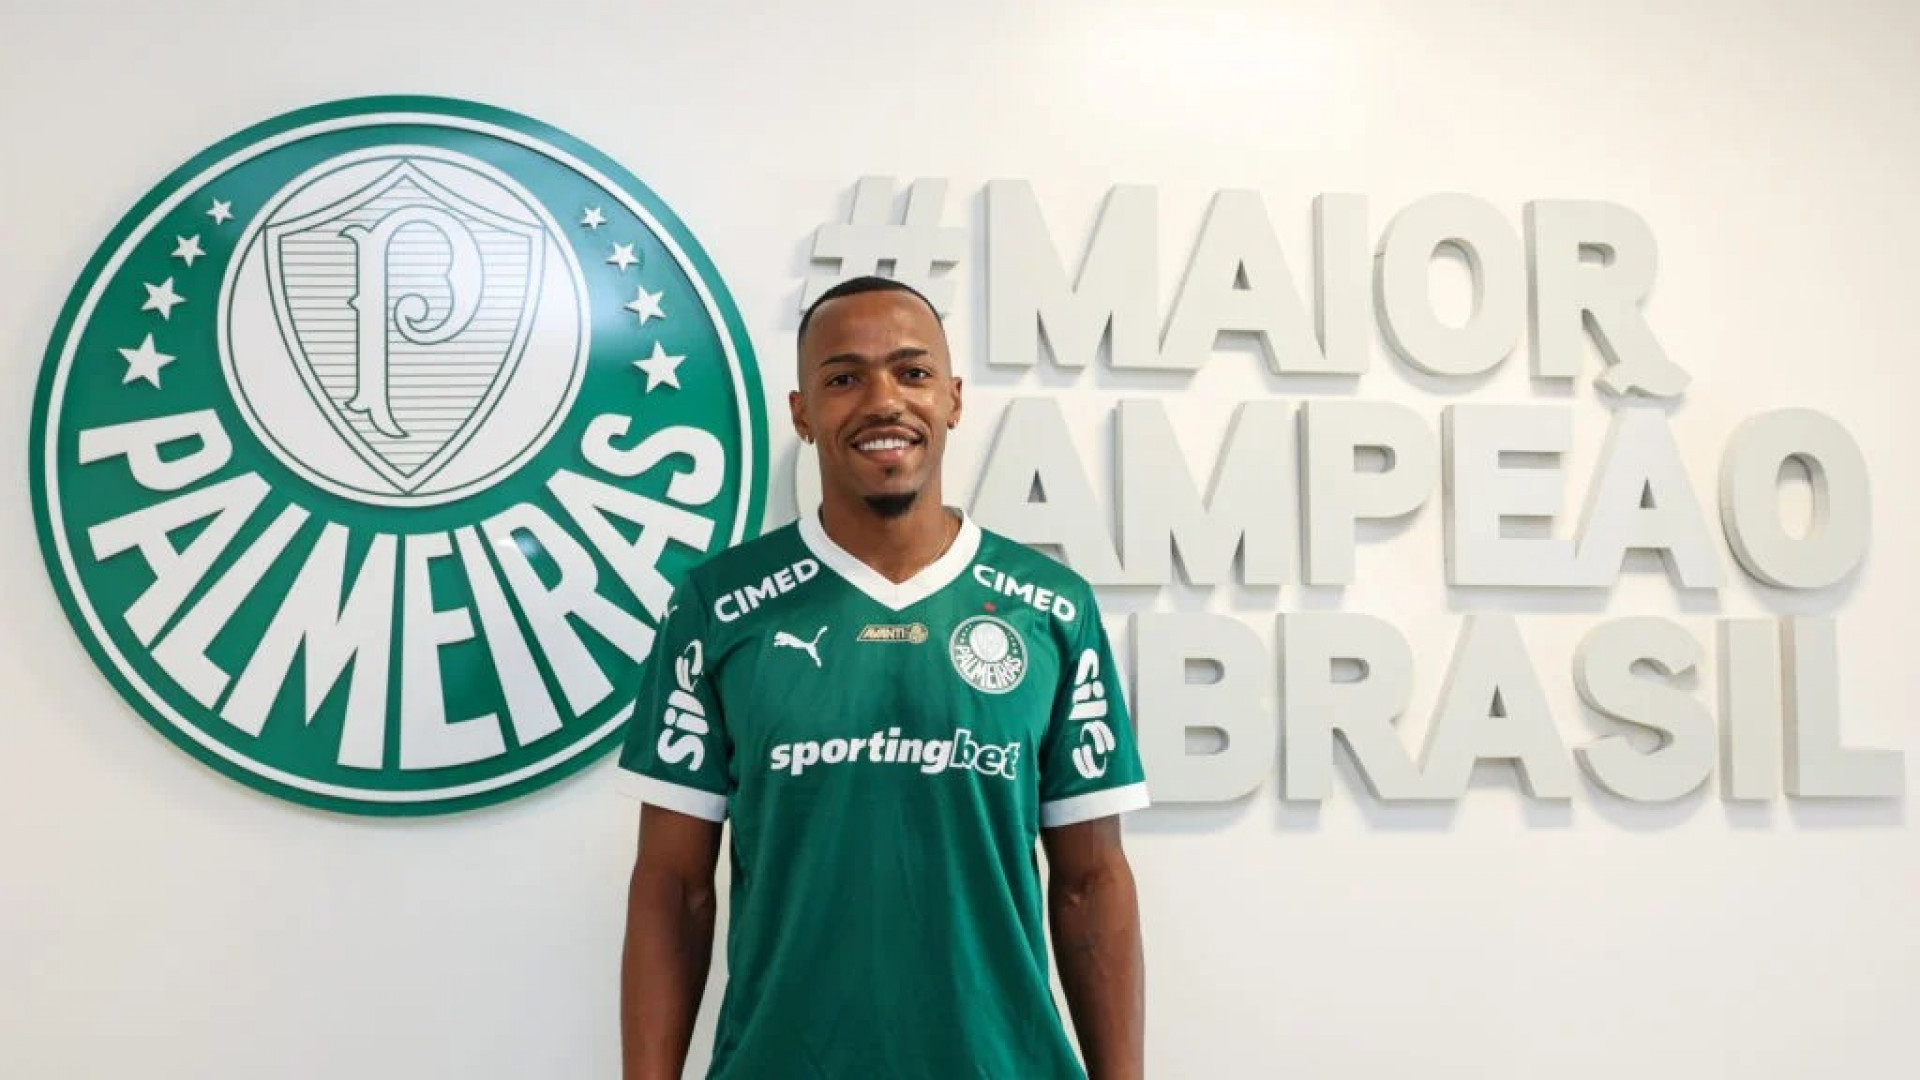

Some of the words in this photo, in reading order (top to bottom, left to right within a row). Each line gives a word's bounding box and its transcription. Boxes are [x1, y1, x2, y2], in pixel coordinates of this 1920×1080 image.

[796, 356, 1872, 592] AMPEÃO
[78, 408, 725, 770] PALMEIRAS
[713, 557, 820, 622] CIMED
[972, 563, 1077, 622] CIMED
[954, 643, 1023, 690] PALMEIRAS
[1132, 611, 1906, 803] BRASIL
[770, 727, 1021, 779] sportingbet
